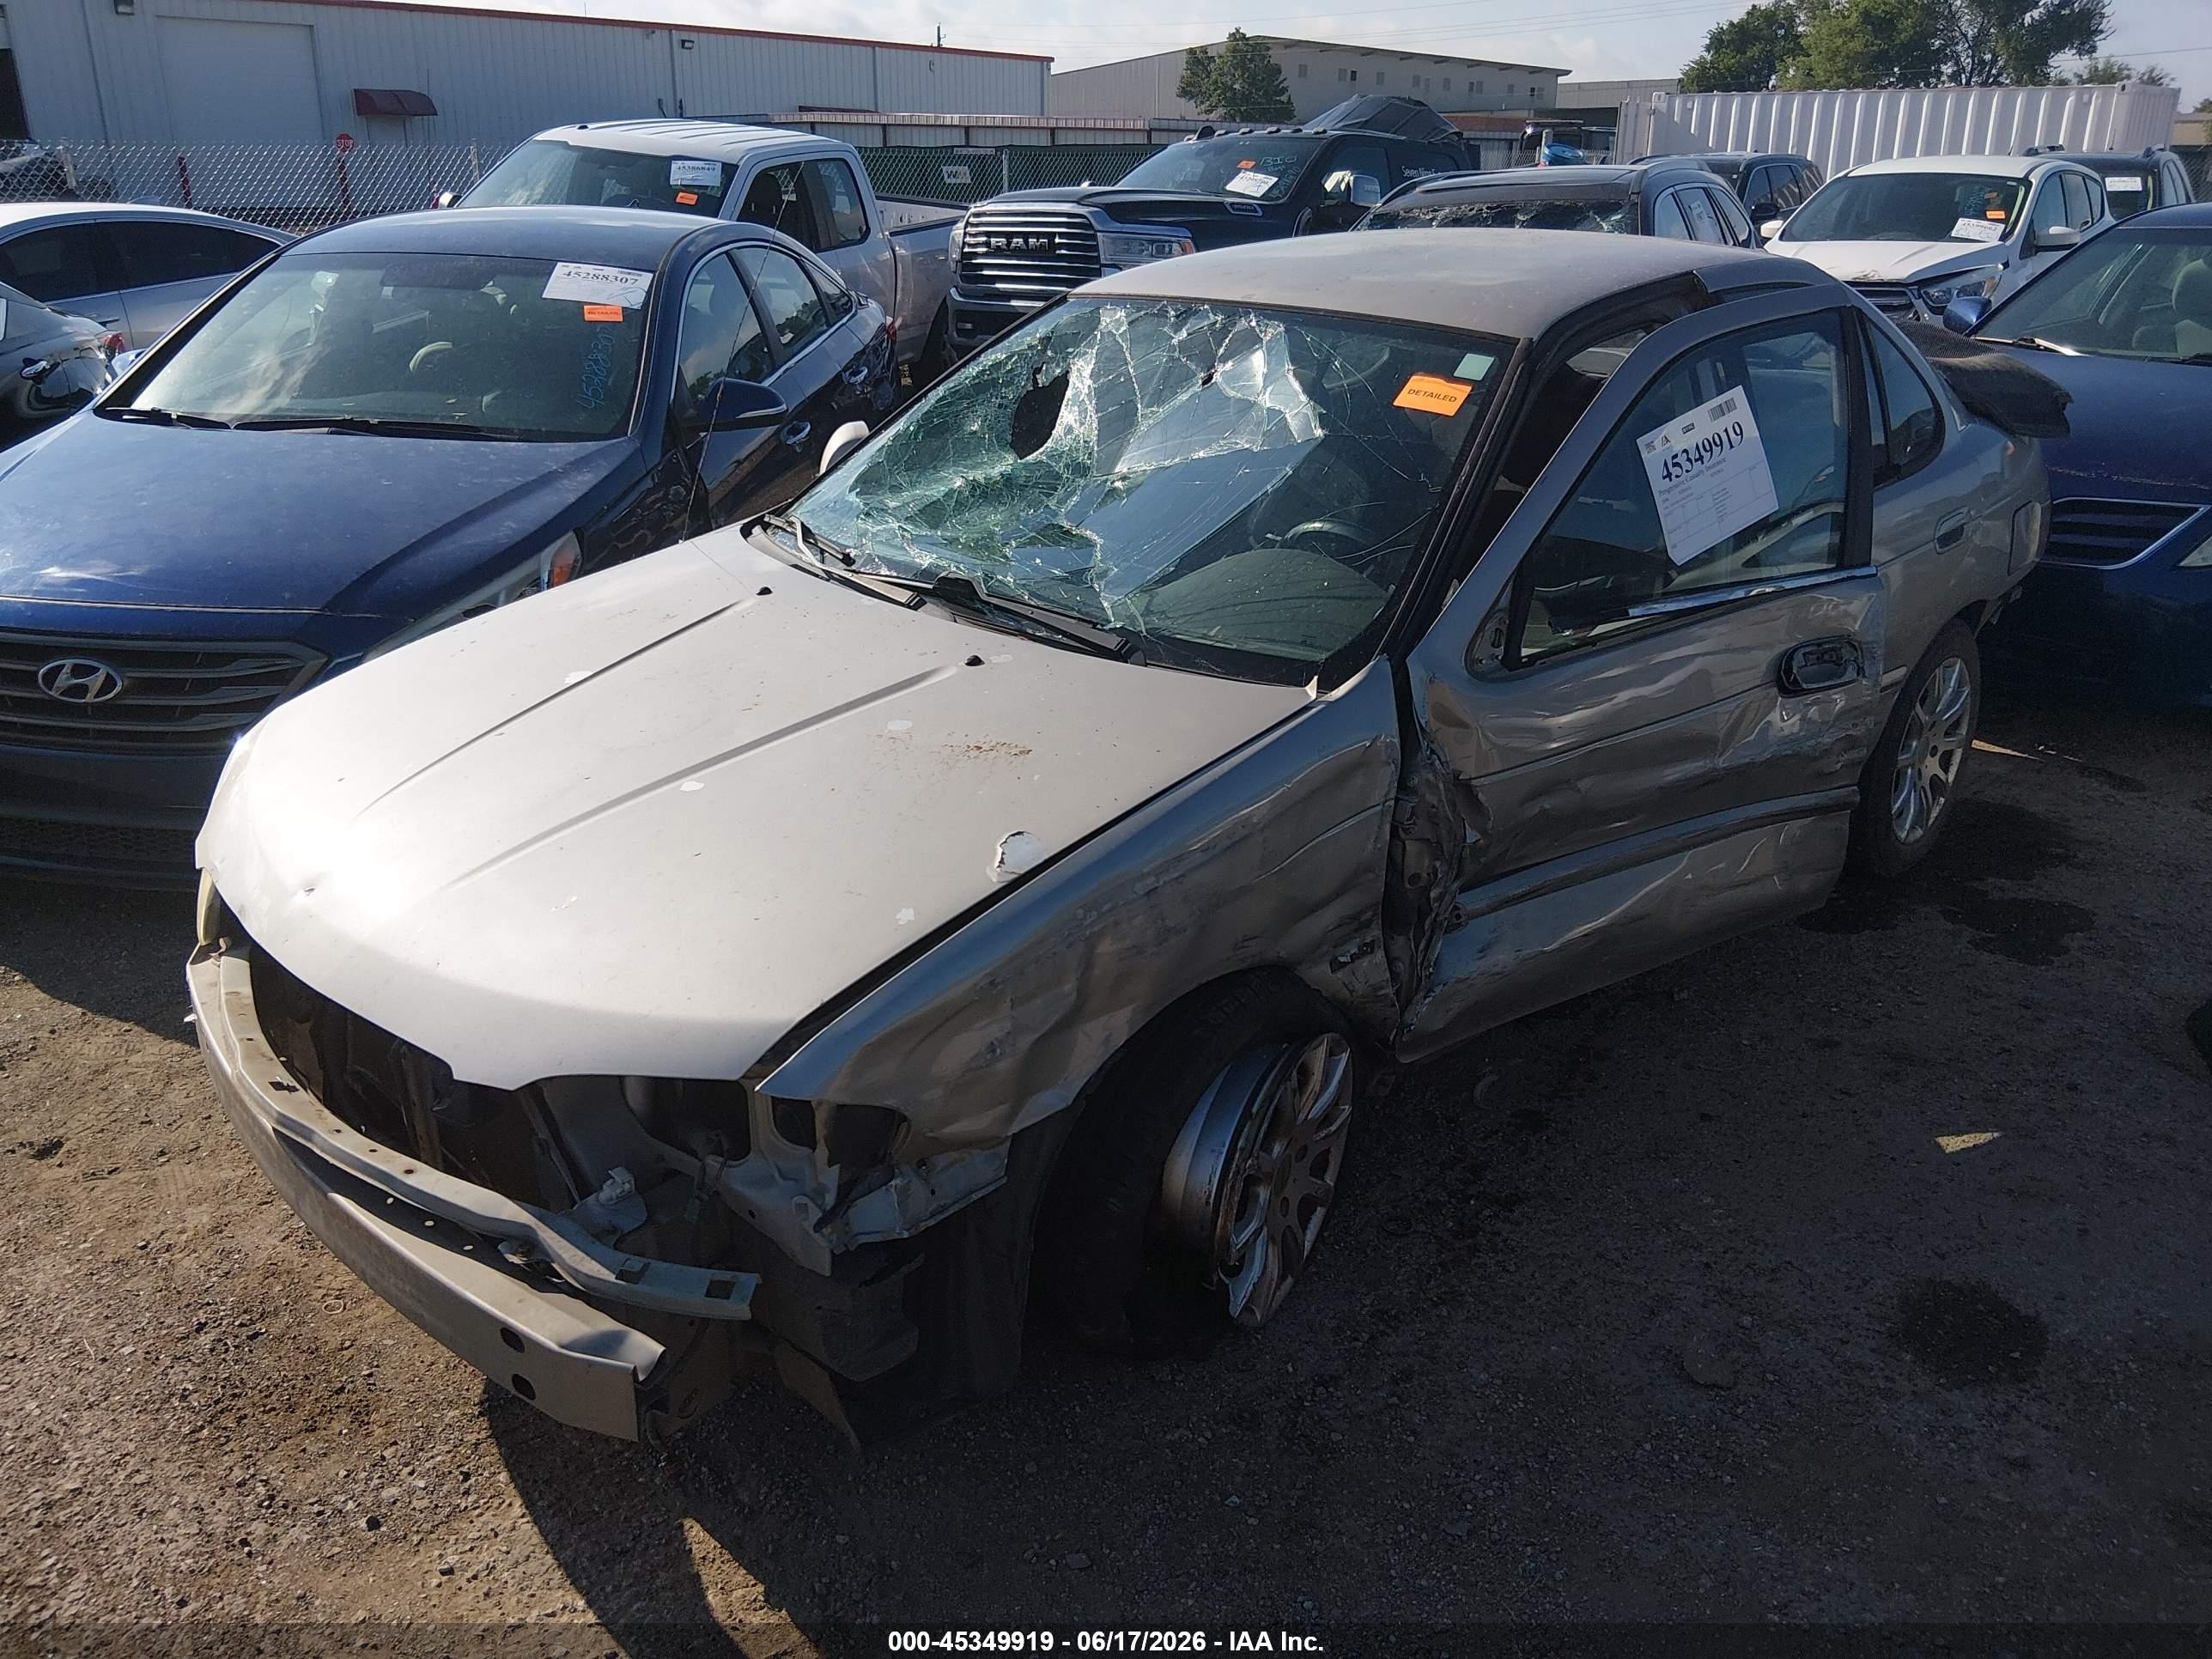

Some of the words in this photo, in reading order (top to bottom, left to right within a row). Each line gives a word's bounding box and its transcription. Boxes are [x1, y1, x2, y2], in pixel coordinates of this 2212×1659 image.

[1401, 165, 1419, 178] Seven
[990, 237, 1048, 251] RAM
[562, 270, 639, 285] 45288307
[1407, 388, 1457, 403] DETAILED
[1662, 421, 1744, 483] 45349919
